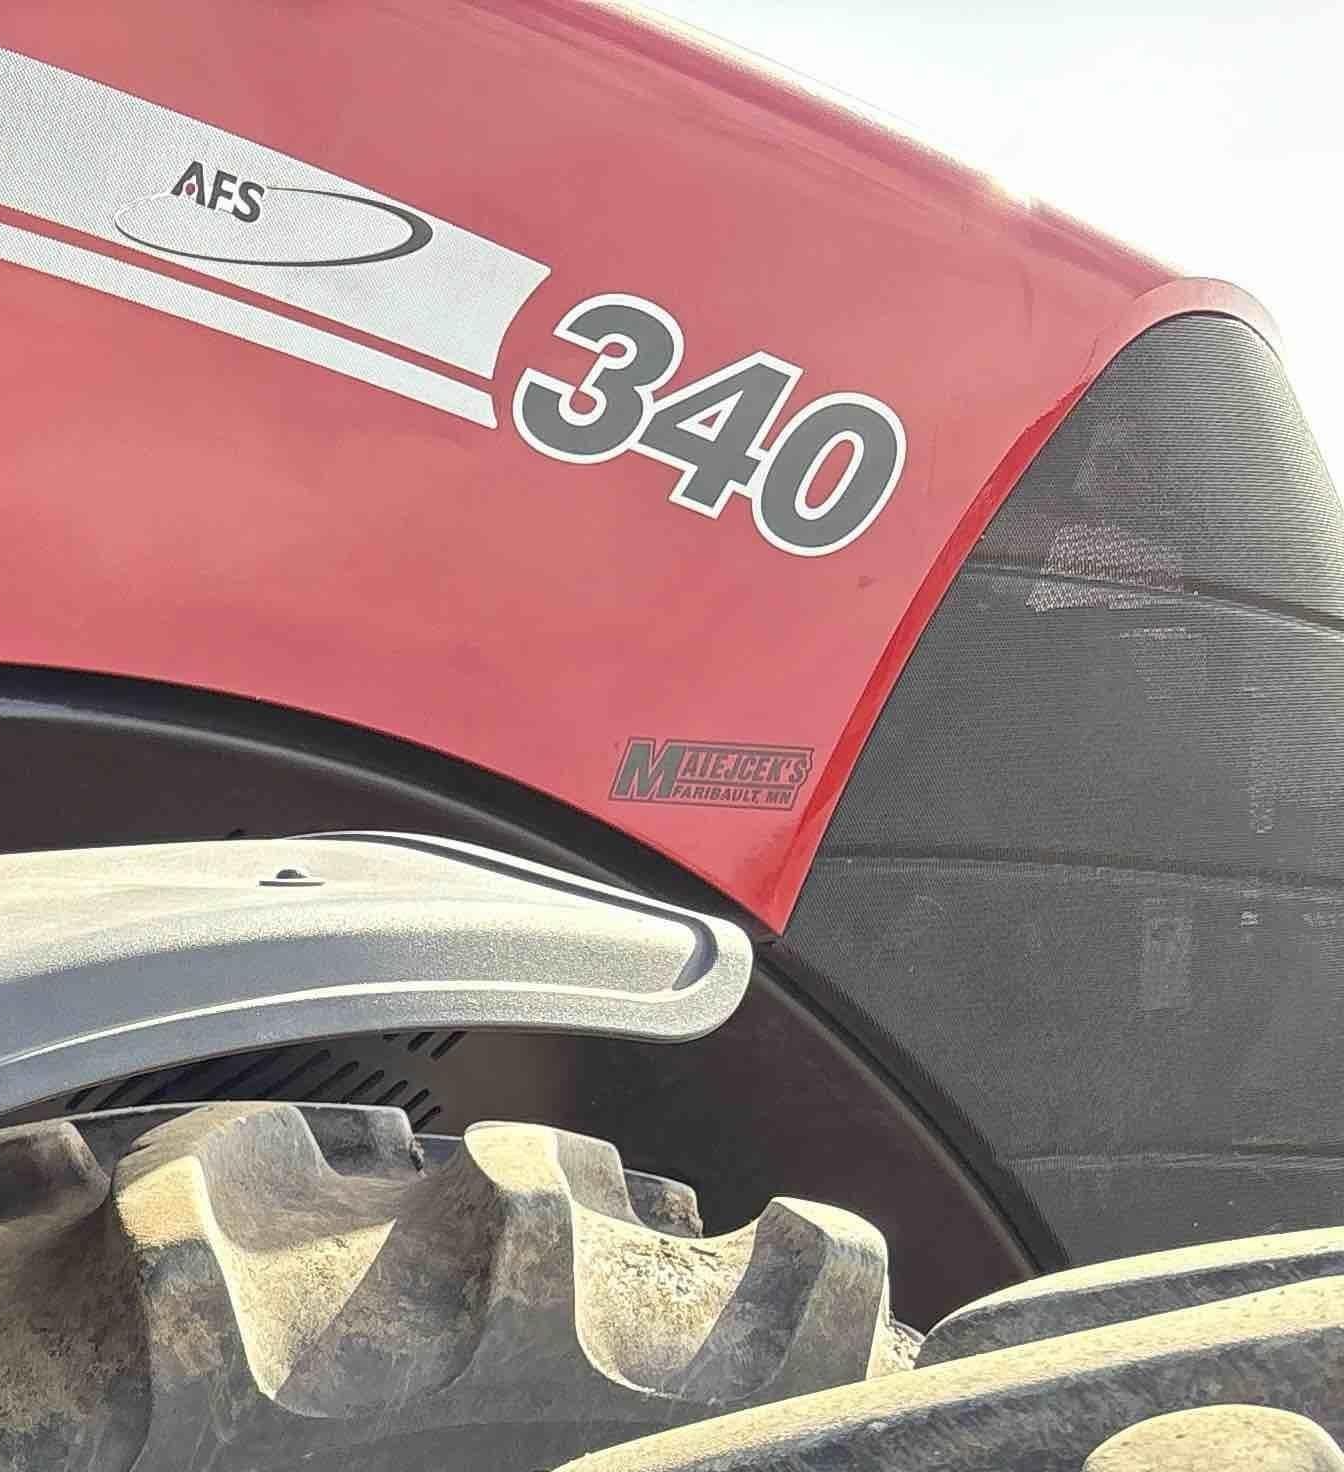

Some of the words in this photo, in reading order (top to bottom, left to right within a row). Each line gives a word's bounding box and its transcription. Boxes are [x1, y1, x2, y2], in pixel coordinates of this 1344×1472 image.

[169, 160, 266, 223] AFS
[511, 292, 907, 557] 340
[765, 790, 793, 805] MN
